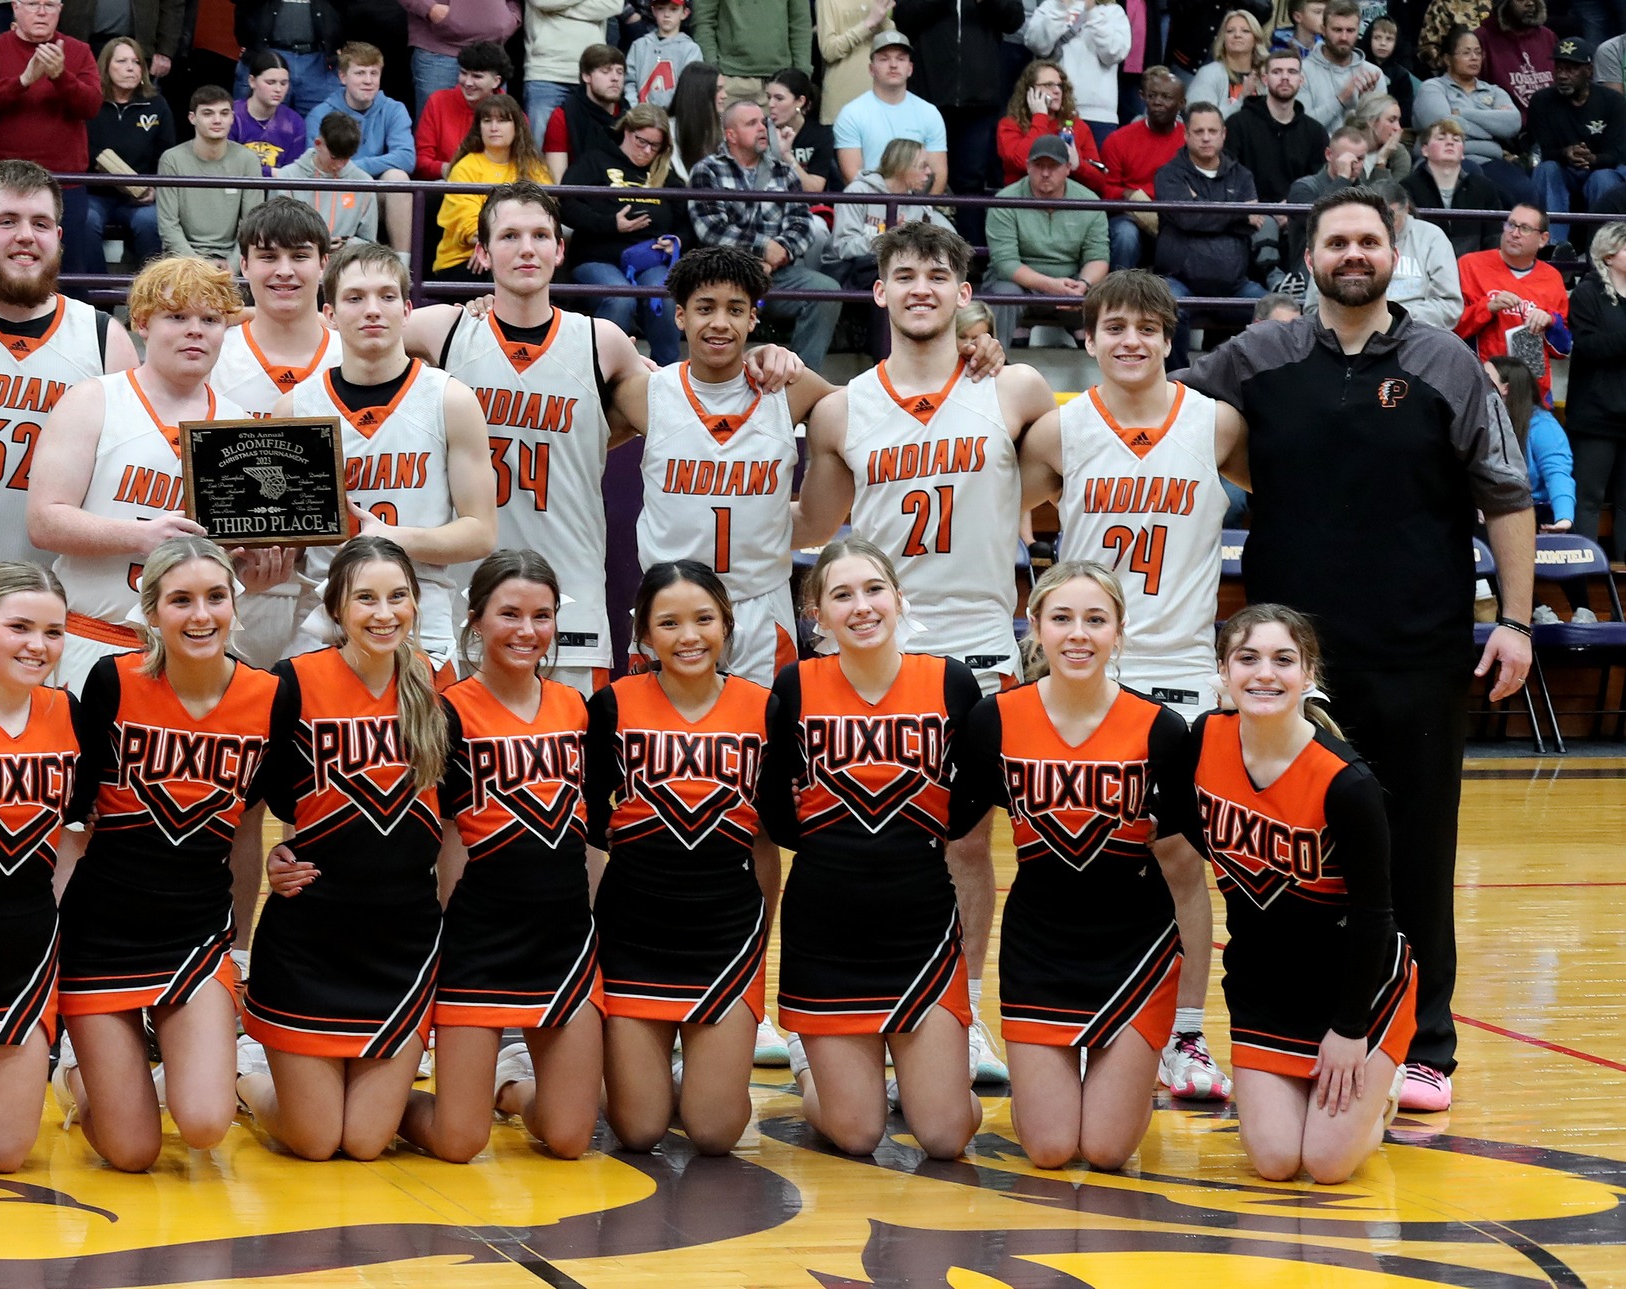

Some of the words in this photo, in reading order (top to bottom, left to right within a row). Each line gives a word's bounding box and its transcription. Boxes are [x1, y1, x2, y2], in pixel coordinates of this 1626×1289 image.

[472, 386, 578, 434] NDIANS
[218, 450, 258, 468] CHRISTMAS
[259, 450, 310, 465] TOURNAMENT
[221, 439, 304, 458] BLOOMFIELD
[344, 452, 431, 491] DIANS
[488, 437, 550, 512] 34
[662, 458, 782, 496] INDIANS
[867, 436, 988, 486] INDIANS
[113, 464, 185, 511] INDI
[901, 485, 955, 557] 21
[1083, 476, 1200, 516] INDIANS
[212, 516, 267, 534] THIRD
[270, 515, 324, 532] PLACE
[711, 506, 731, 574] 1
[1102, 524, 1168, 596] 24
[117, 720, 263, 801] PUXICO
[312, 715, 411, 796] PUXI
[469, 730, 586, 816] PUXIC
[623, 728, 762, 804] PUXICO
[805, 713, 945, 790] PUXICO
[1001, 754, 1147, 826] PUXICO
[1196, 785, 1323, 883] PUXICO
